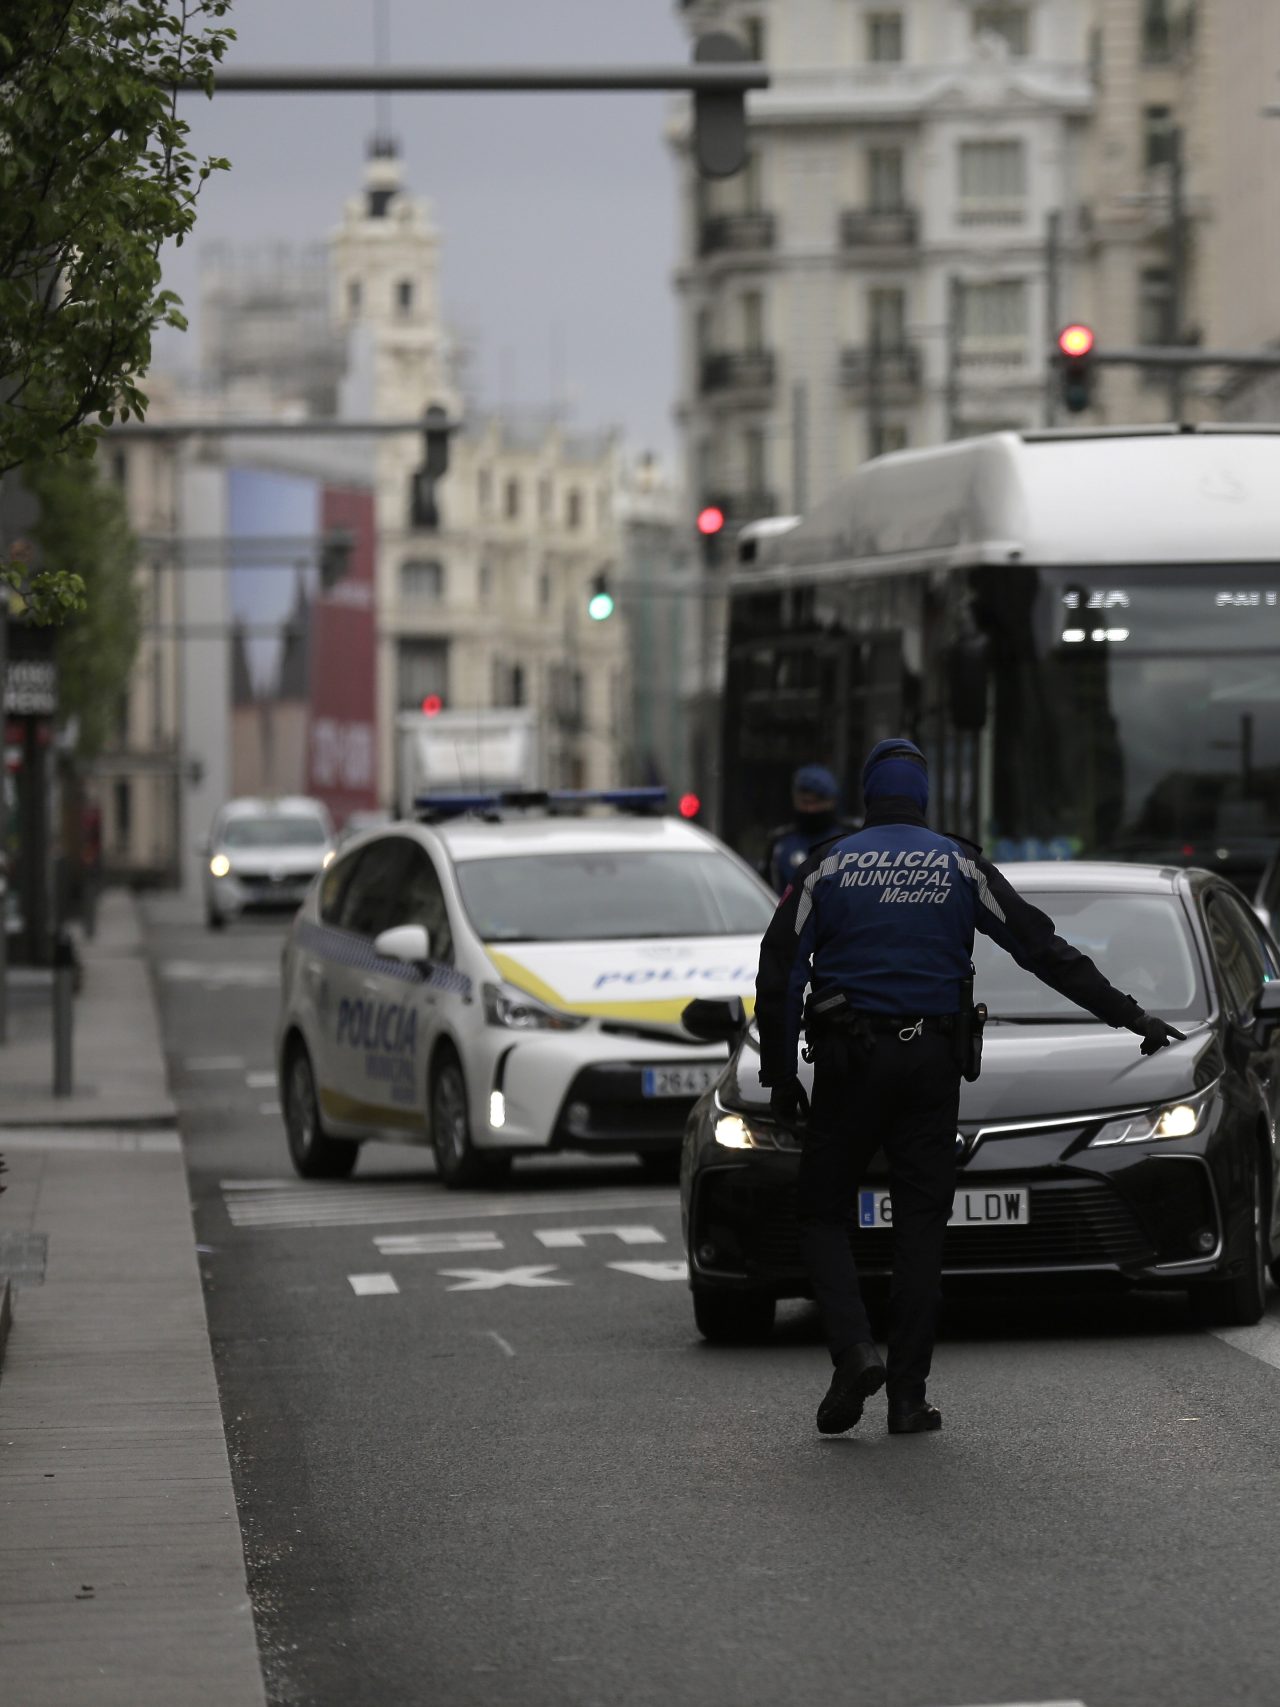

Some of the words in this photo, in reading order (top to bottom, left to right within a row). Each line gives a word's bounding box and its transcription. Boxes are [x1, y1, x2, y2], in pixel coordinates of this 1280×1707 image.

[838, 849, 949, 870] POLICÍA
[839, 869, 952, 888] MUNICIPAL
[879, 887, 951, 904] Madrid
[965, 1193, 1021, 1222] LDW
